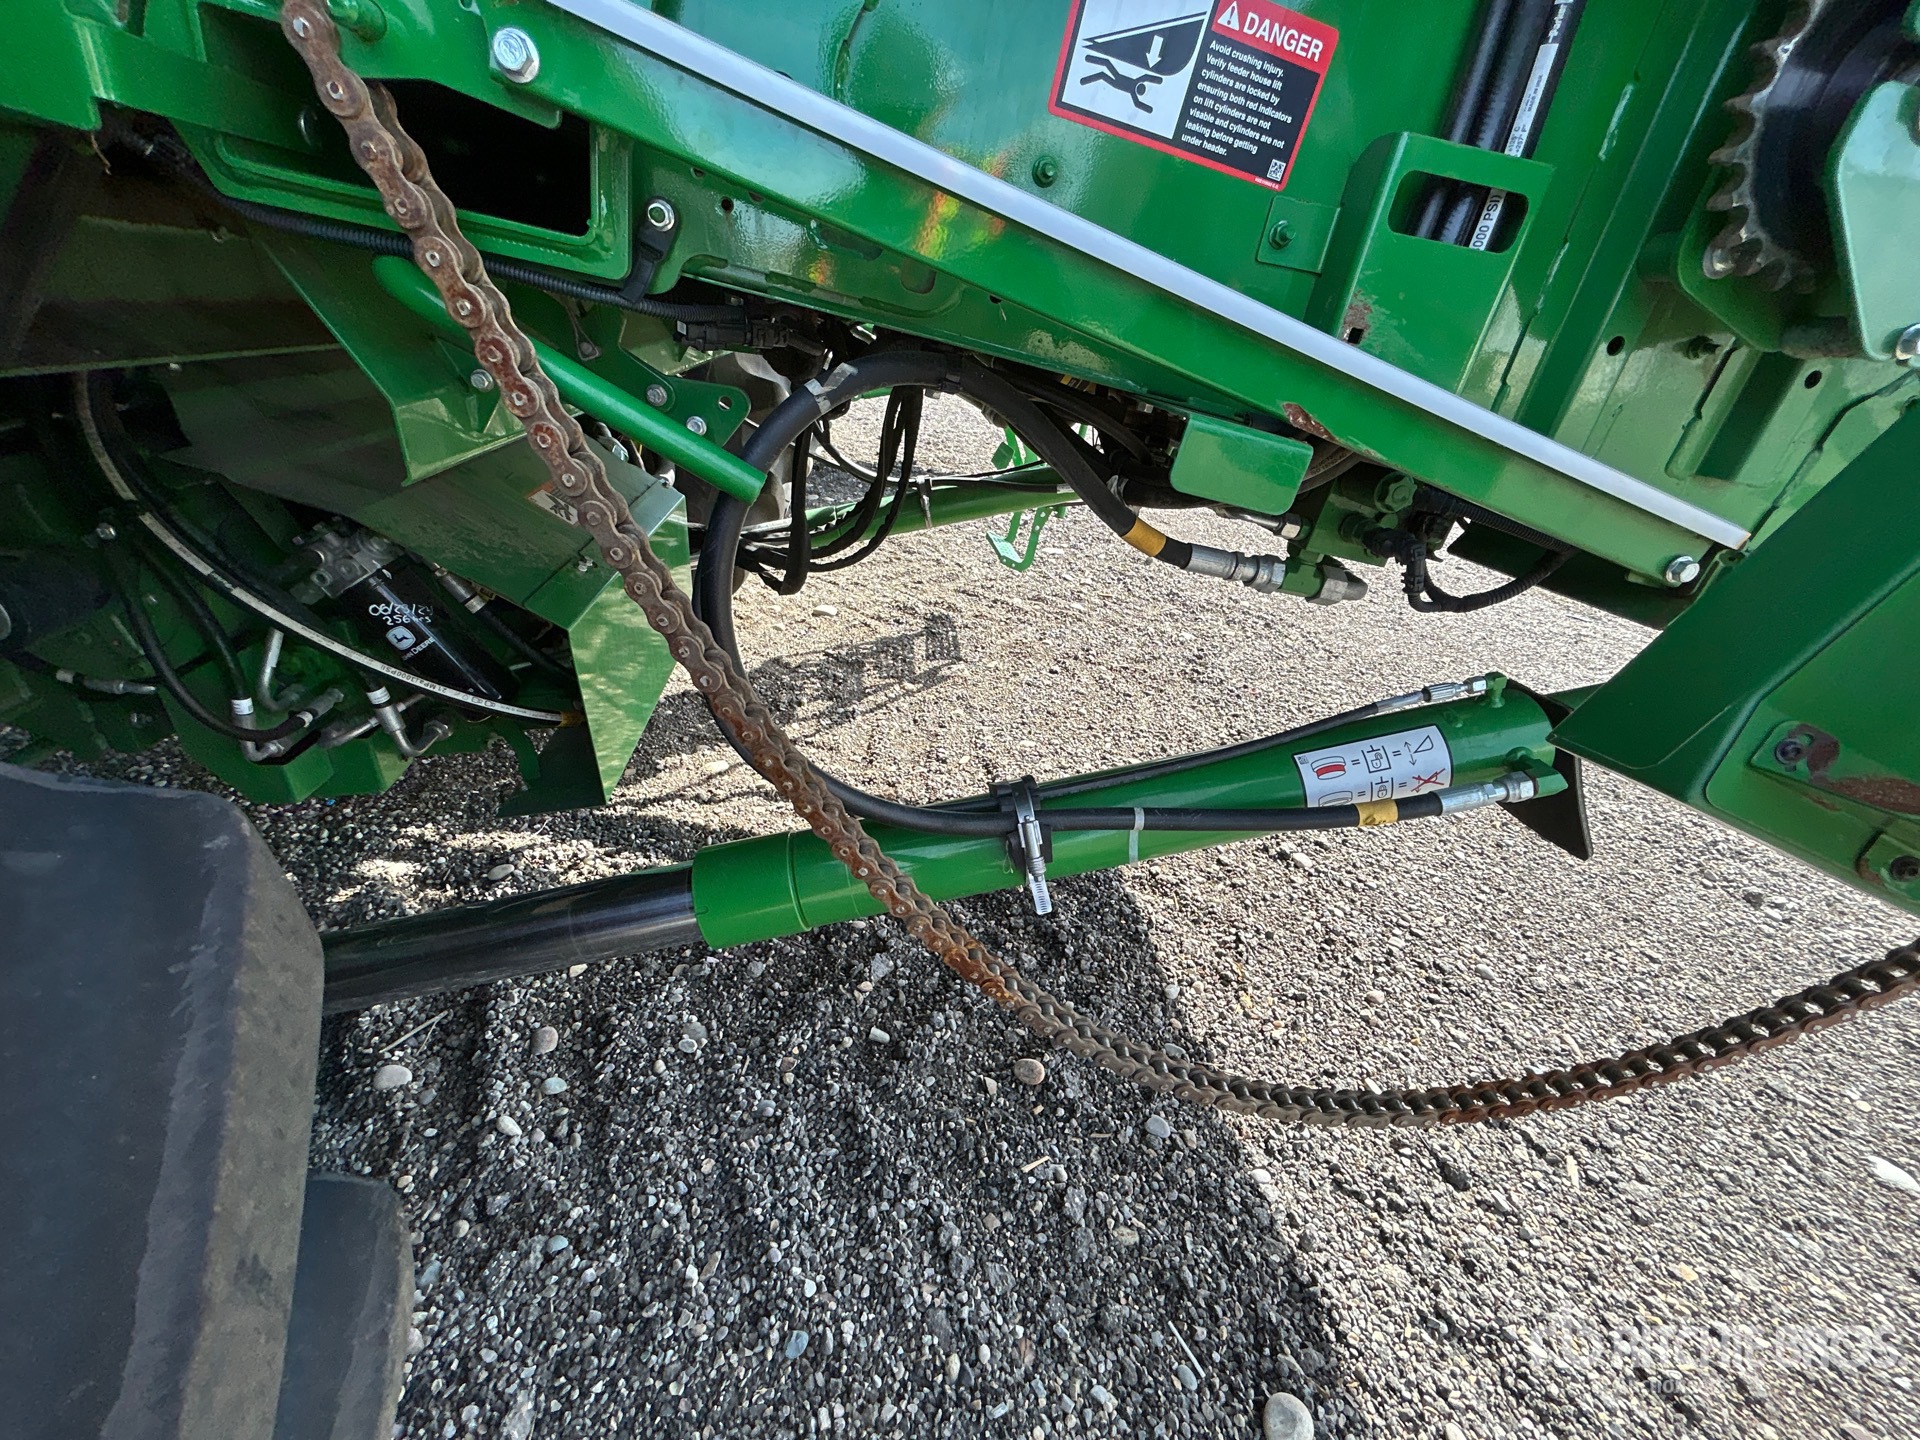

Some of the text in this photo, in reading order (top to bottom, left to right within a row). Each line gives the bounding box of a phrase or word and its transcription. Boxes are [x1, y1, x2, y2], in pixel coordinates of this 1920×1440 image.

[1243, 12, 1323, 62] DANGER
[1206, 54, 1283, 91] Verify feeder house lift
[1210, 40, 1284, 77] Avoid crushing injury.
[1197, 82, 1292, 124] ensuring both red indicators
[1202, 69, 1280, 106] cylinders are locked by
[1190, 108, 1285, 149] visable and cylinders are not
[1193, 96, 1272, 130] on lift cylinders are not
[1182, 134, 1227, 156] under header.
[1185, 120, 1258, 155] leaking before getting
[1472, 194, 1504, 250] 000 PSI)
[382, 614, 411, 626] 256
[410, 636, 436, 656] DEERE
